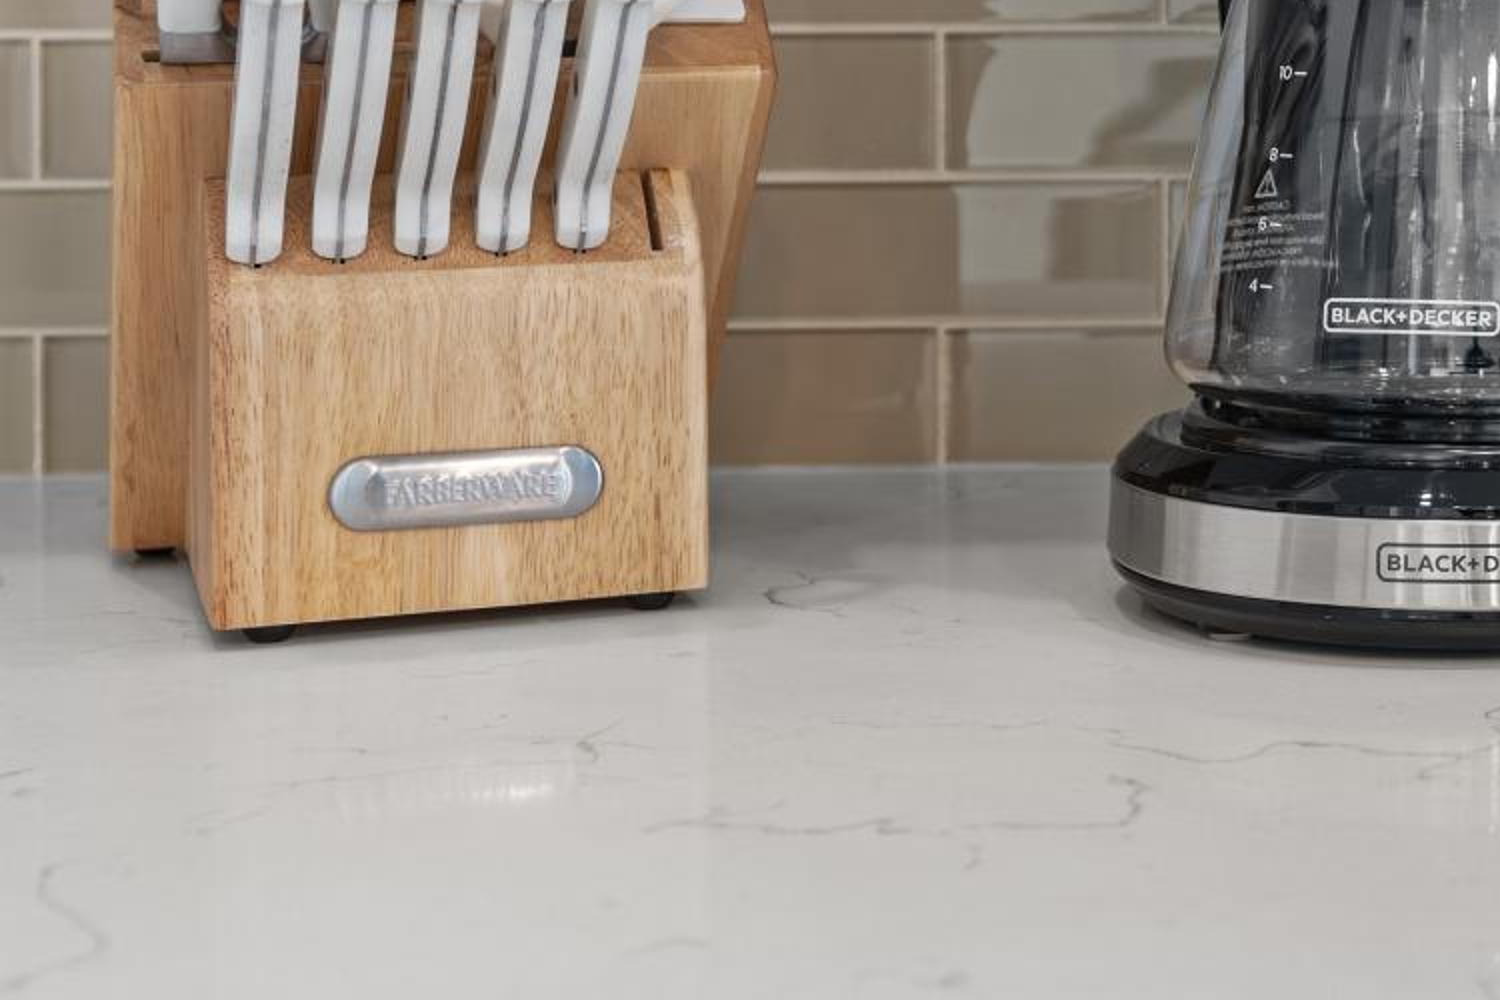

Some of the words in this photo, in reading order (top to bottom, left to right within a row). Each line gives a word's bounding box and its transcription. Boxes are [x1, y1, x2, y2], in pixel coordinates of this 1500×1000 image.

[1279, 65, 1292, 81] 10
[1269, 147, 1279, 162] 8
[1249, 278, 1259, 293] 4
[1331, 307, 1493, 328] BLACK+DECKER
[384, 470, 560, 508] FARBERWARE
